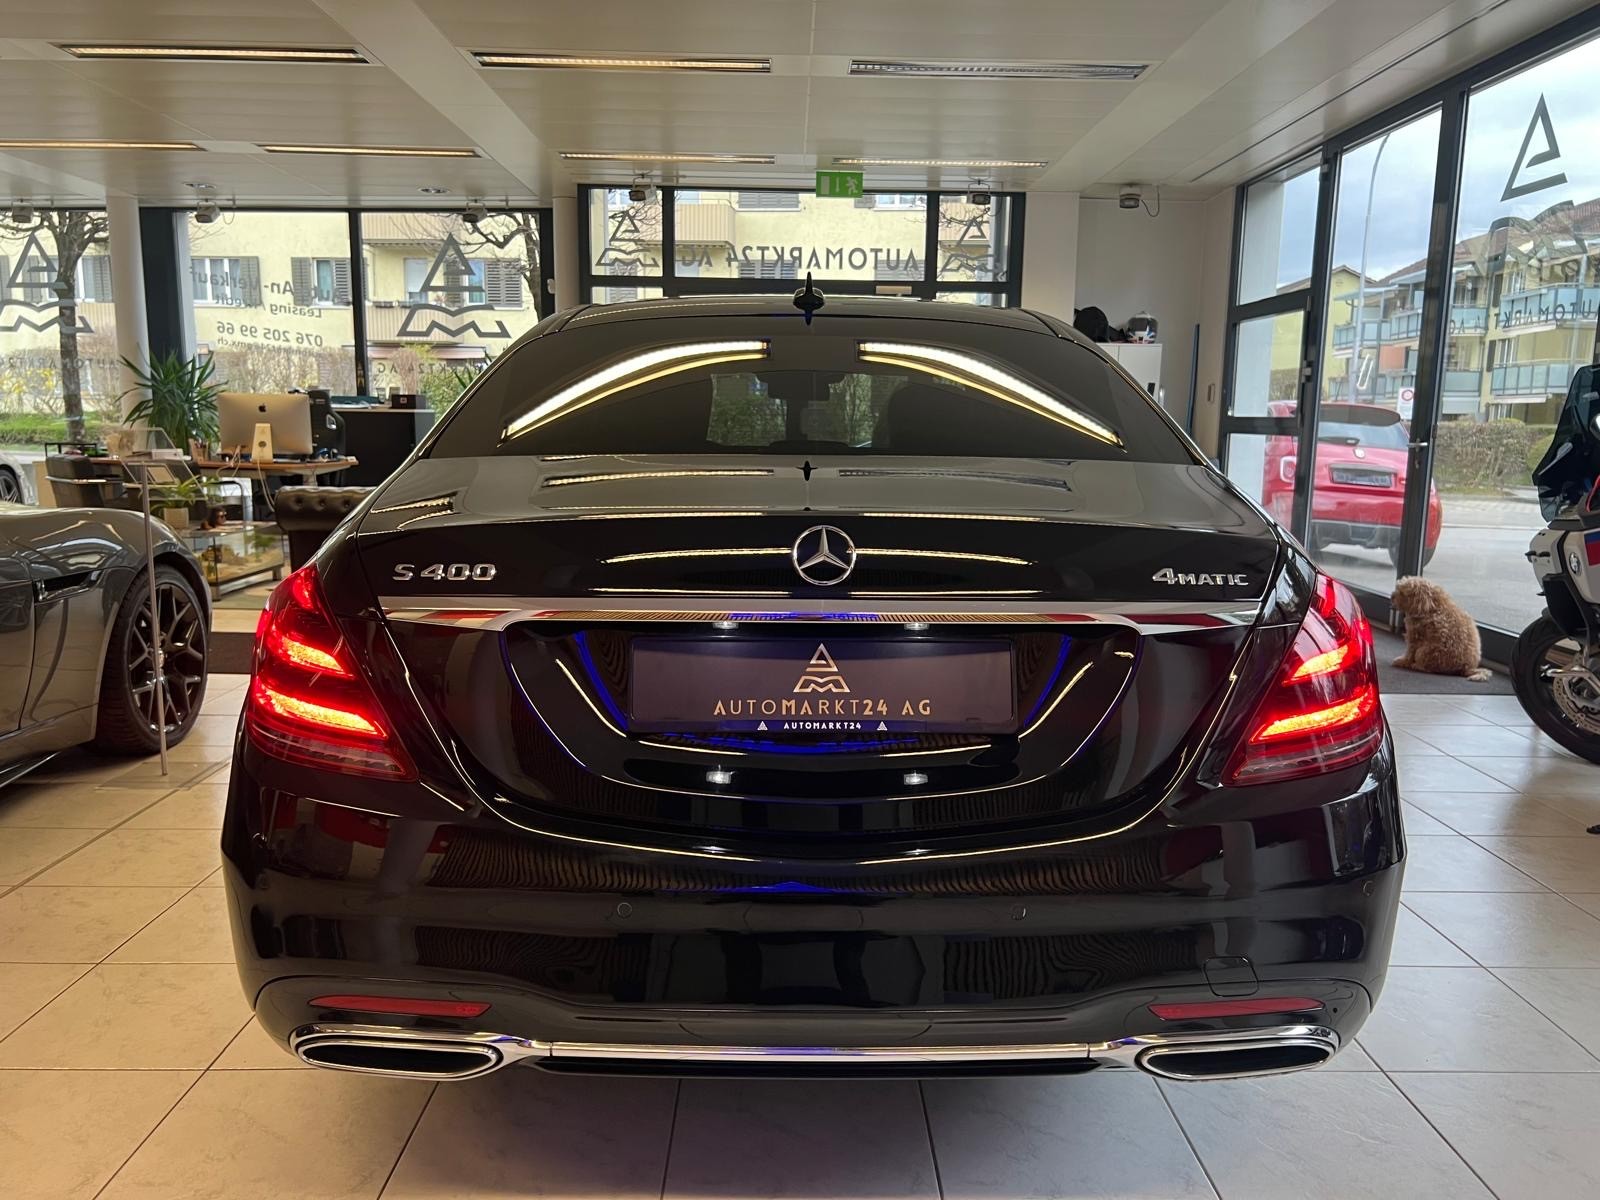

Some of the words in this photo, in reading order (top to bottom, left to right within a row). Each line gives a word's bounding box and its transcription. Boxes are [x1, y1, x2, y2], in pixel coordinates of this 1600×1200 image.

[392, 563, 416, 581] S
[420, 563, 497, 581] 400
[1152, 567, 1249, 586] 4MATIC
[713, 698, 888, 716] AUTOMARKT24
[901, 698, 932, 716] AG
[783, 721, 862, 731] AUTOMARKT24
